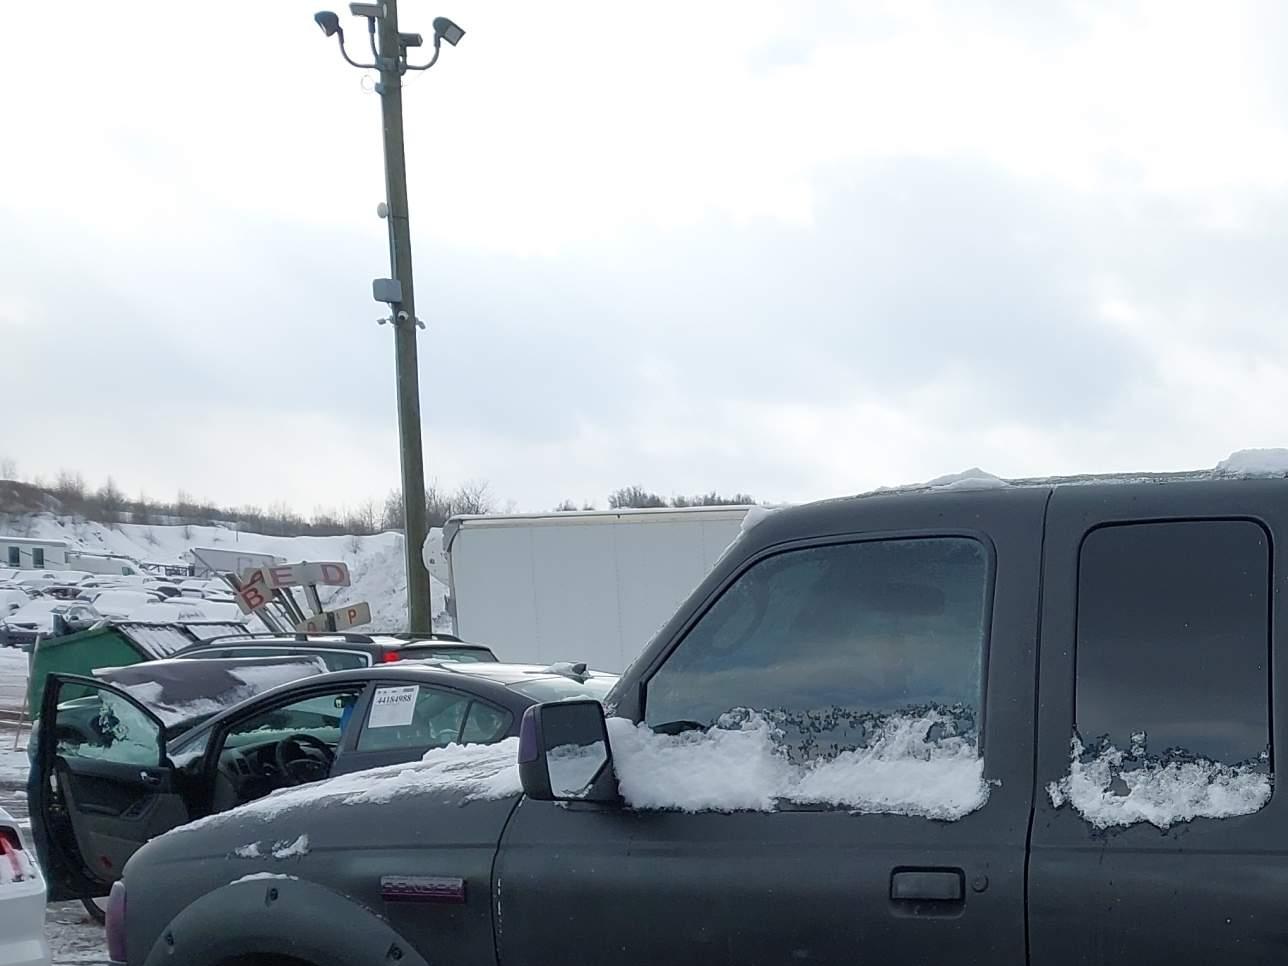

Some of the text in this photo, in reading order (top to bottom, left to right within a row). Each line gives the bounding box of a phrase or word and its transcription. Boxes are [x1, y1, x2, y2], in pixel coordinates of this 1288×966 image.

[269, 567, 297, 588] E
[320, 564, 345, 585] D
[244, 587, 264, 609] B
[347, 608, 357, 624] P
